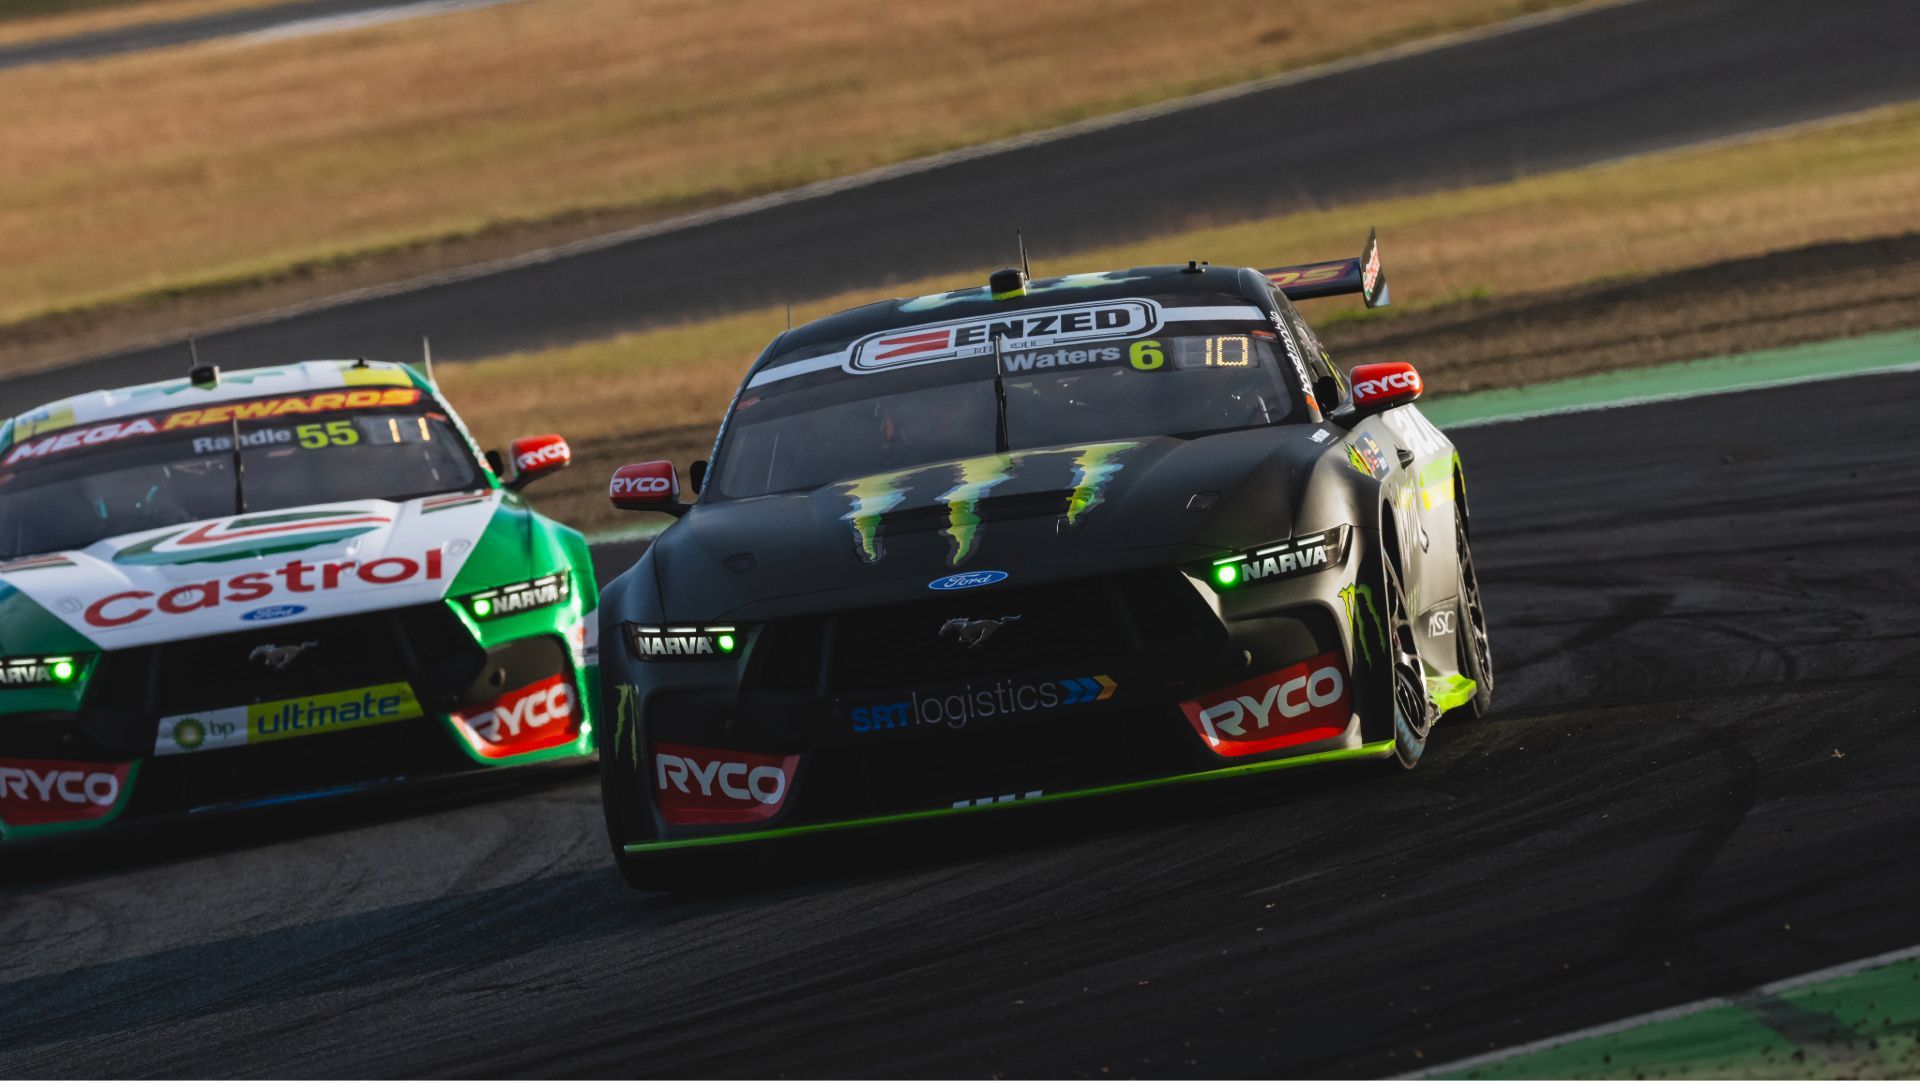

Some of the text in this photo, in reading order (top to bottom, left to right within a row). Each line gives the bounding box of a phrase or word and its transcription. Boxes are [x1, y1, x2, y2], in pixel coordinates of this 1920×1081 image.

[955, 308, 1131, 346] ENZED
[1004, 340, 1165, 373] Waters 6
[1205, 336, 1249, 366] 10
[1353, 370, 1420, 399] RYCO
[5, 389, 420, 465] MEGA REWARDS
[192, 420, 359, 454] Randle 55
[517, 442, 570, 469] RYCO
[612, 477, 671, 493] RYCO
[1241, 546, 1328, 582] NARVA
[942, 573, 992, 589] Ford
[250, 605, 296, 620] Ford
[493, 584, 559, 614] NARVA
[639, 636, 714, 655] NARVA
[0, 665, 52, 684] ARVA
[257, 692, 401, 735] ultimate
[464, 682, 575, 743] RYCO
[1199, 666, 1343, 747] RYCO
[208, 720, 236, 739] bp
[0, 767, 119, 806] RYCO
[655, 753, 786, 805] RYCO
